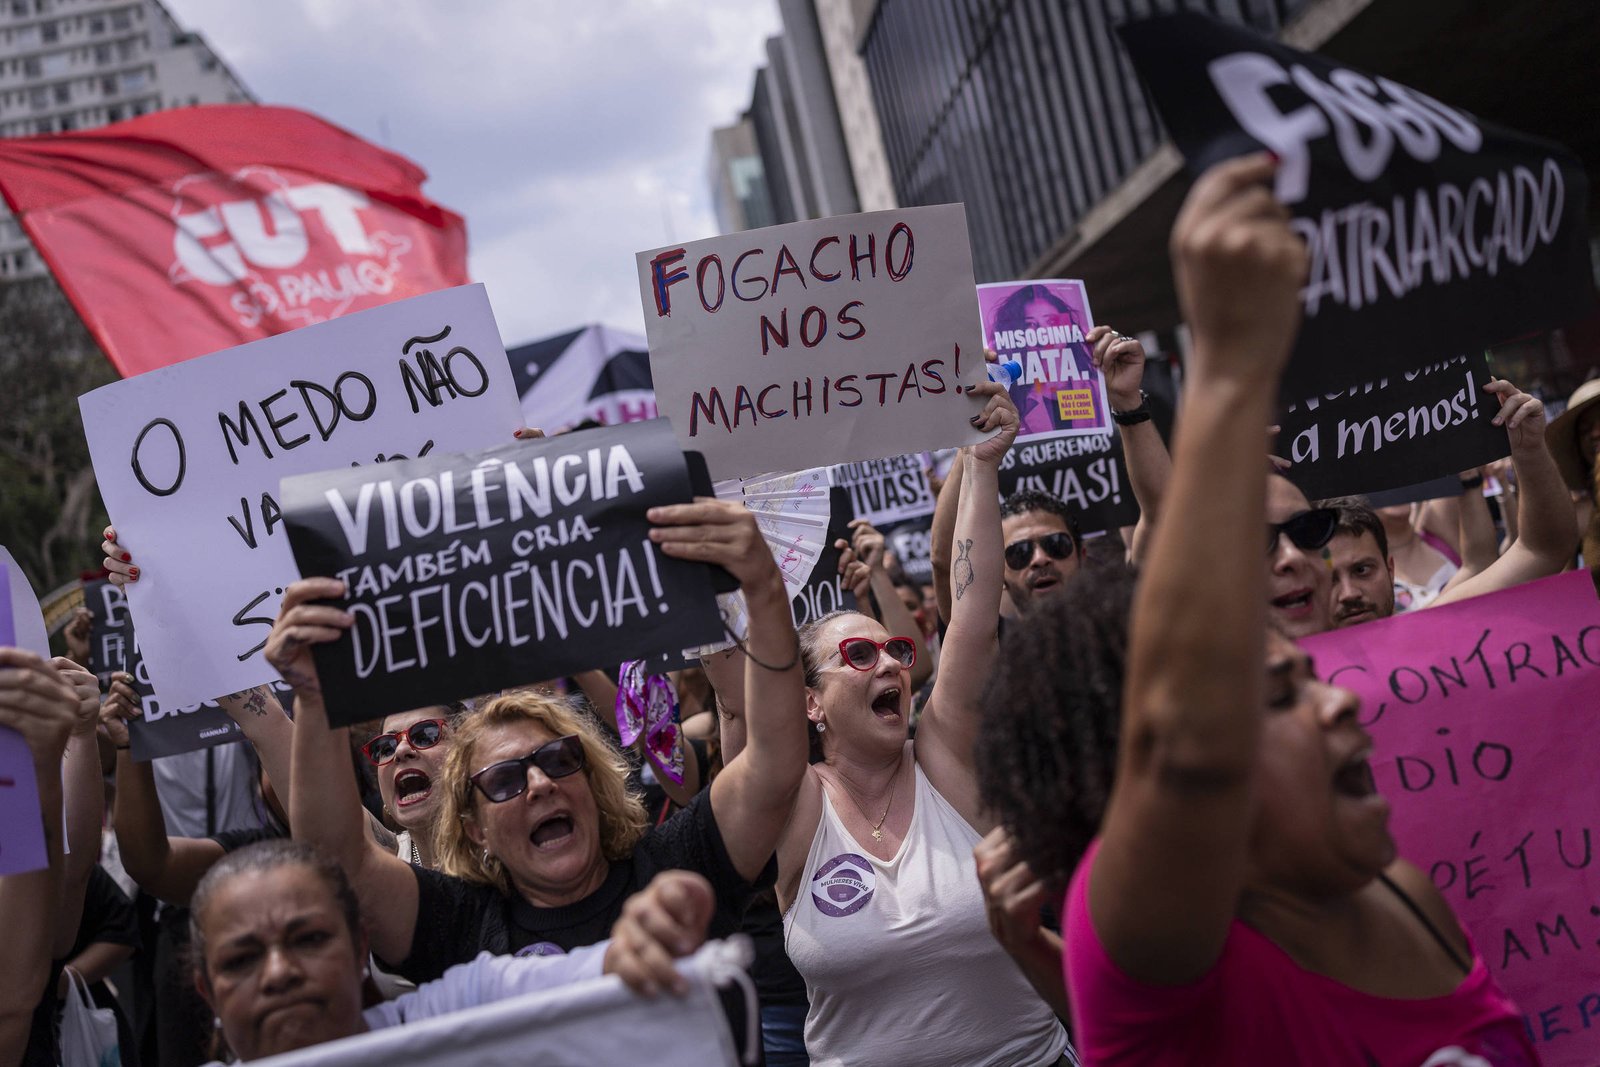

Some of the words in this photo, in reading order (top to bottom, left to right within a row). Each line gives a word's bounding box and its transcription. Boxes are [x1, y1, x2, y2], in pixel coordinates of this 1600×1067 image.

[173, 183, 372, 287] CUT
[650, 222, 915, 317] FOGACHO
[278, 258, 393, 307] PAULO
[760, 301, 867, 356] NOS
[994, 324, 1084, 350] MISOGINIA
[131, 417, 187, 496] O
[218, 371, 377, 465] MEDO
[398, 325, 490, 413] NÃO
[688, 342, 963, 437] MACHISTAS!
[1291, 423, 1320, 464] a
[1337, 370, 1479, 460] menos!
[1019, 432, 1114, 467] QUEREMOS
[325, 443, 645, 556] VIOLÊNCIA
[846, 470, 928, 516] IVAS!
[337, 538, 493, 599] TAMBÉM
[347, 539, 669, 679] DEFICIÊNCIA!
[820, 878, 853, 888] MULHERES
[853, 880, 870, 892] VIVAS
